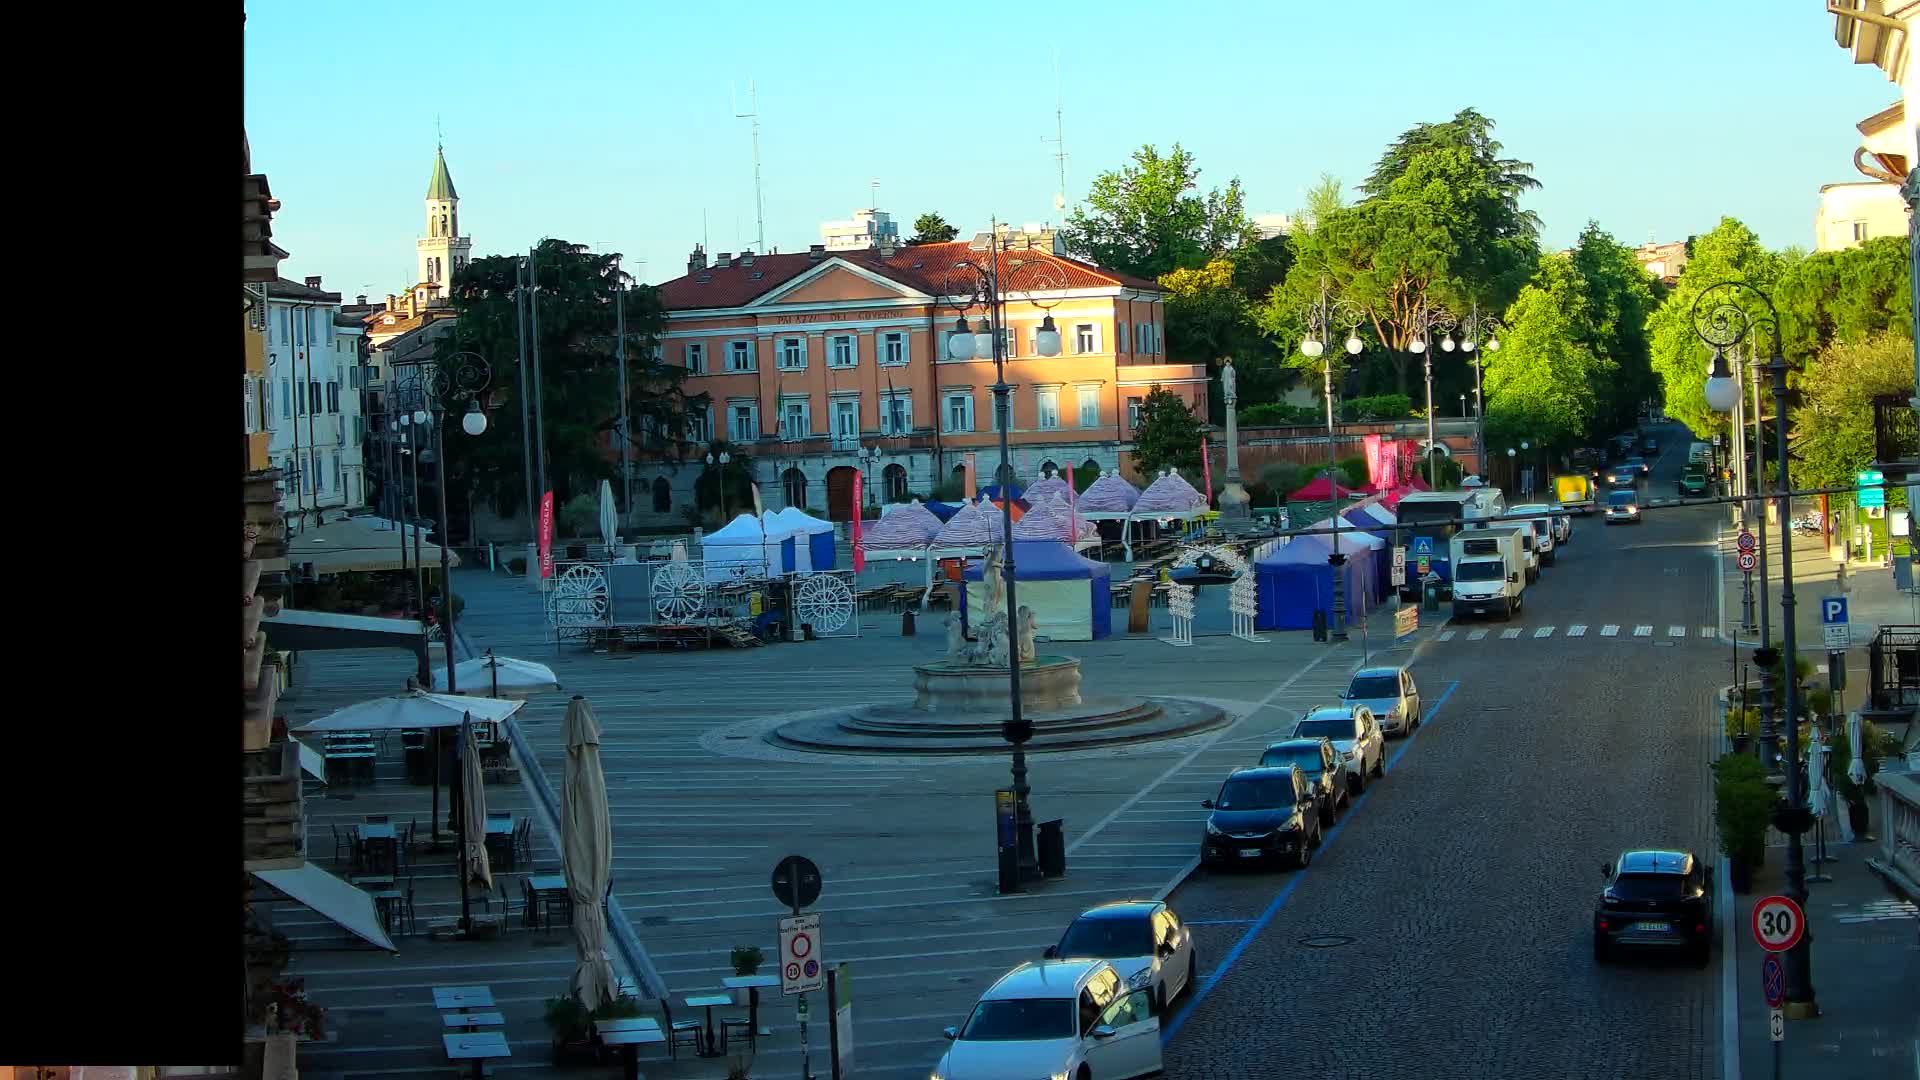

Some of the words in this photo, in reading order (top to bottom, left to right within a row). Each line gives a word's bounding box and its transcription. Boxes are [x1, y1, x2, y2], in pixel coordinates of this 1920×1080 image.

[1742, 556, 1753, 566] 20
[1827, 601, 1842, 621] P
[1762, 910, 1791, 936] 30
